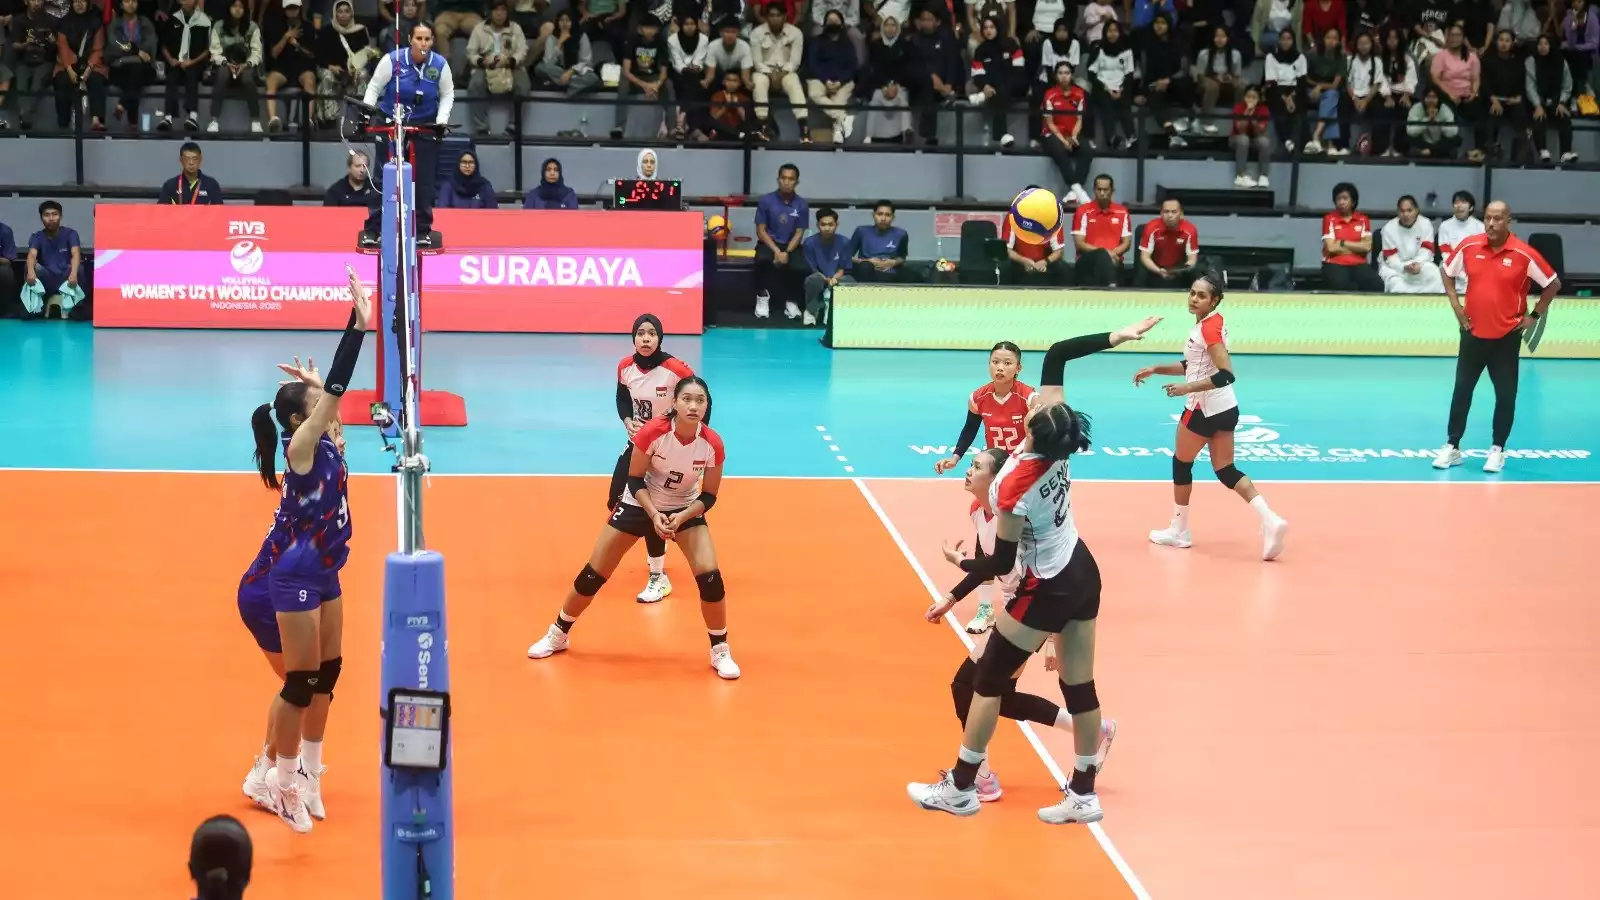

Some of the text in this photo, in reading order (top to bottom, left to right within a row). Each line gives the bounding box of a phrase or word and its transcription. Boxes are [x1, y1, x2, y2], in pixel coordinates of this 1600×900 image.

[228, 221, 266, 235] FIVB
[459, 255, 645, 287] SURABAYA
[221, 276, 272, 286] VOLLEYBALL
[120, 284, 373, 302] WOMEN'S U21 WORLD CHAMPIONSP
[210, 301, 258, 310] INDONESIA
[989, 426, 1019, 451] 22
[1100, 446, 1175, 457] U21
[664, 470, 684, 489] 2
[337, 495, 348, 530] 9
[612, 506, 625, 521] 2
[299, 589, 307, 602] 9
